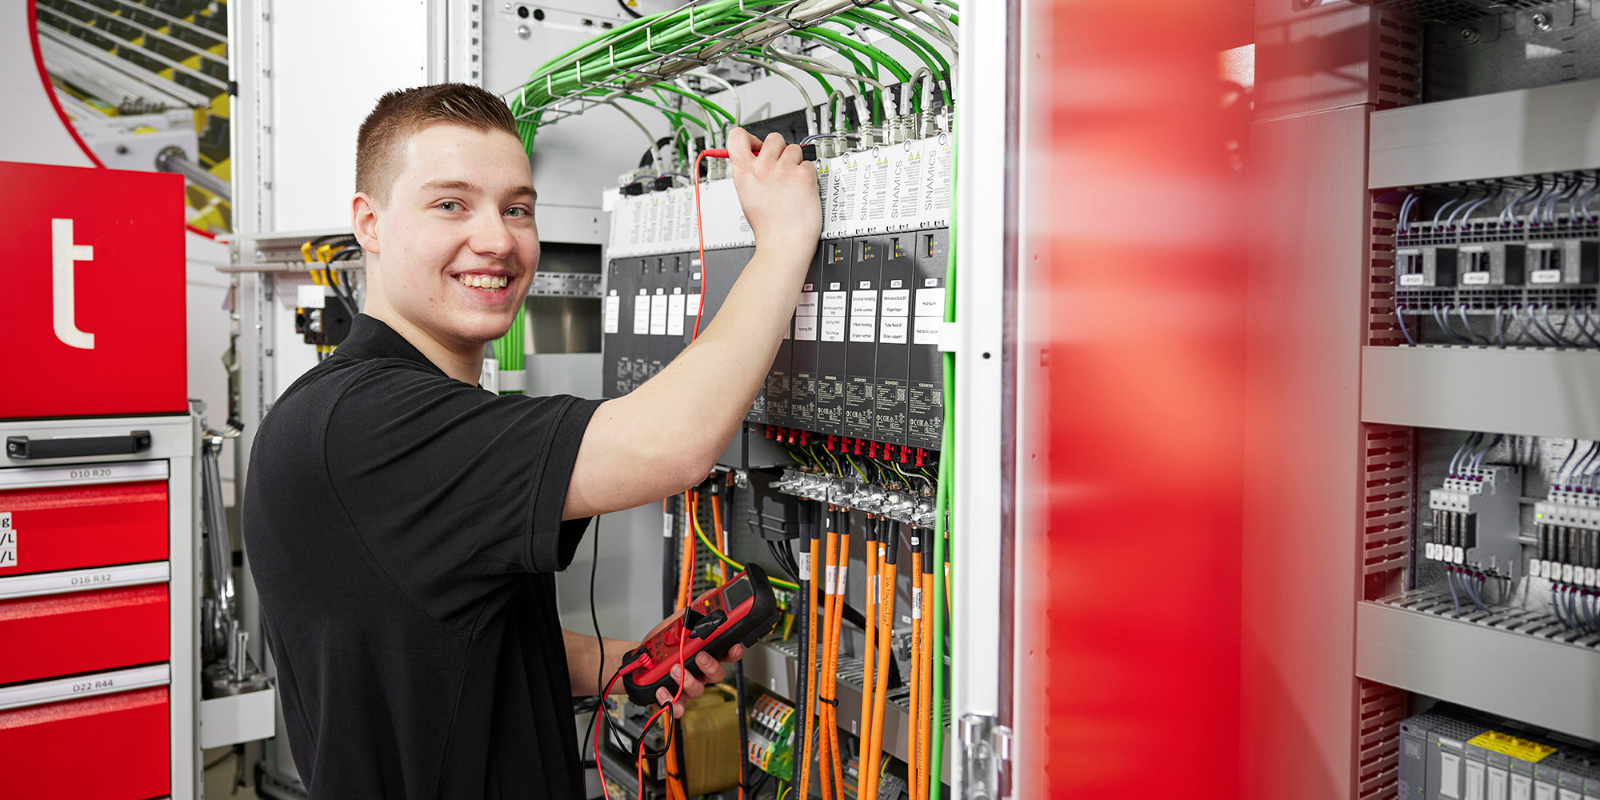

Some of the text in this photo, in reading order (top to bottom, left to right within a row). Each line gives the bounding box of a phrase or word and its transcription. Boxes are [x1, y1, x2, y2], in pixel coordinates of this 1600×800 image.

[831, 168, 842, 222] SINAMICS
[860, 164, 872, 220] SINAMICS
[891, 160, 902, 218] SINAMICS
[925, 150, 936, 210] SINAMICS
[52, 218, 95, 350] t
[0, 518, 10, 528] g
[71, 574, 111, 585] D16 R32
[73, 680, 113, 692] D22 R44
